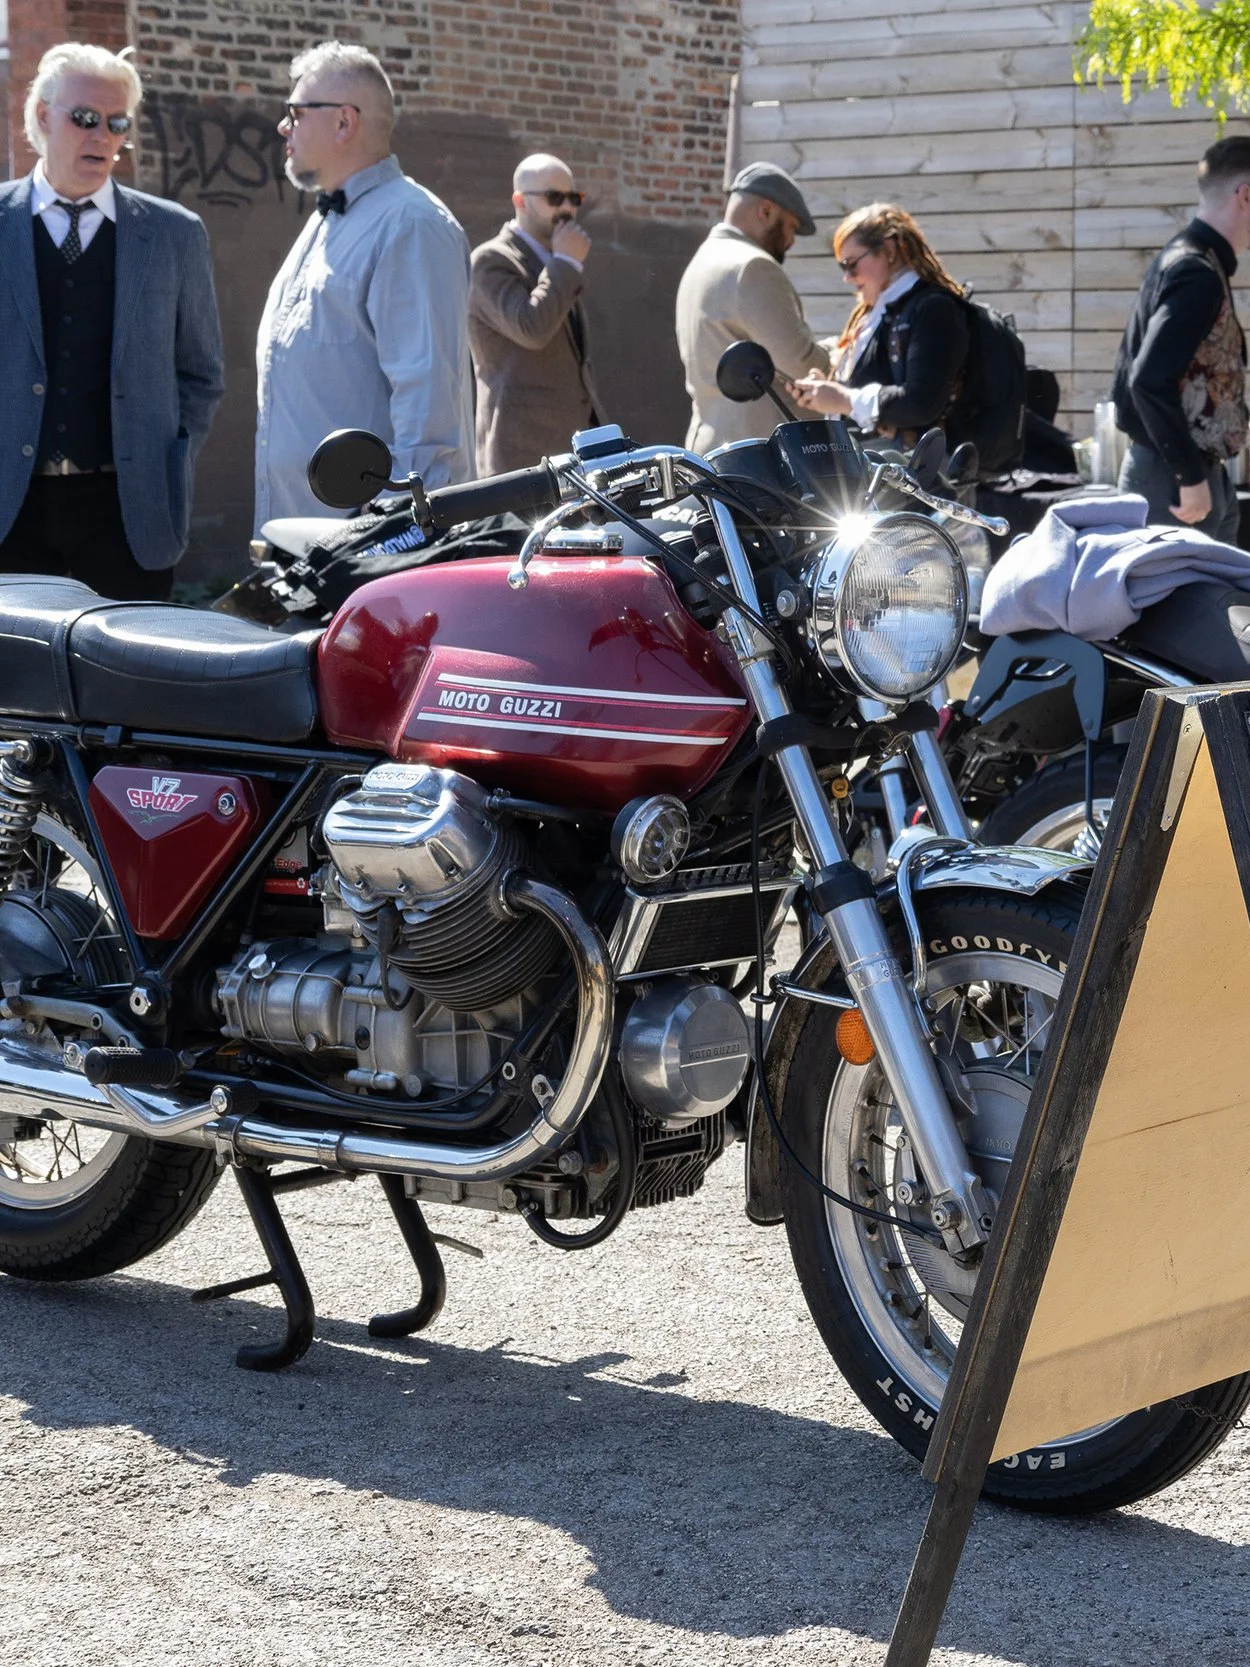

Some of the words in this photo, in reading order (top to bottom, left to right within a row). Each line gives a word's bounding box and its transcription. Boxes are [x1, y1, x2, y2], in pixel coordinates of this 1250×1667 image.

[802, 443, 828, 454] MOTO
[438, 690, 490, 711] MOTO
[500, 697, 562, 718] GUZZI
[152, 776, 181, 796] V7
[126, 788, 198, 812] SPORT
[689, 1047, 711, 1060] MOTO
[713, 1043, 740, 1056] GUZZI
[876, 1377, 934, 1431] HST
